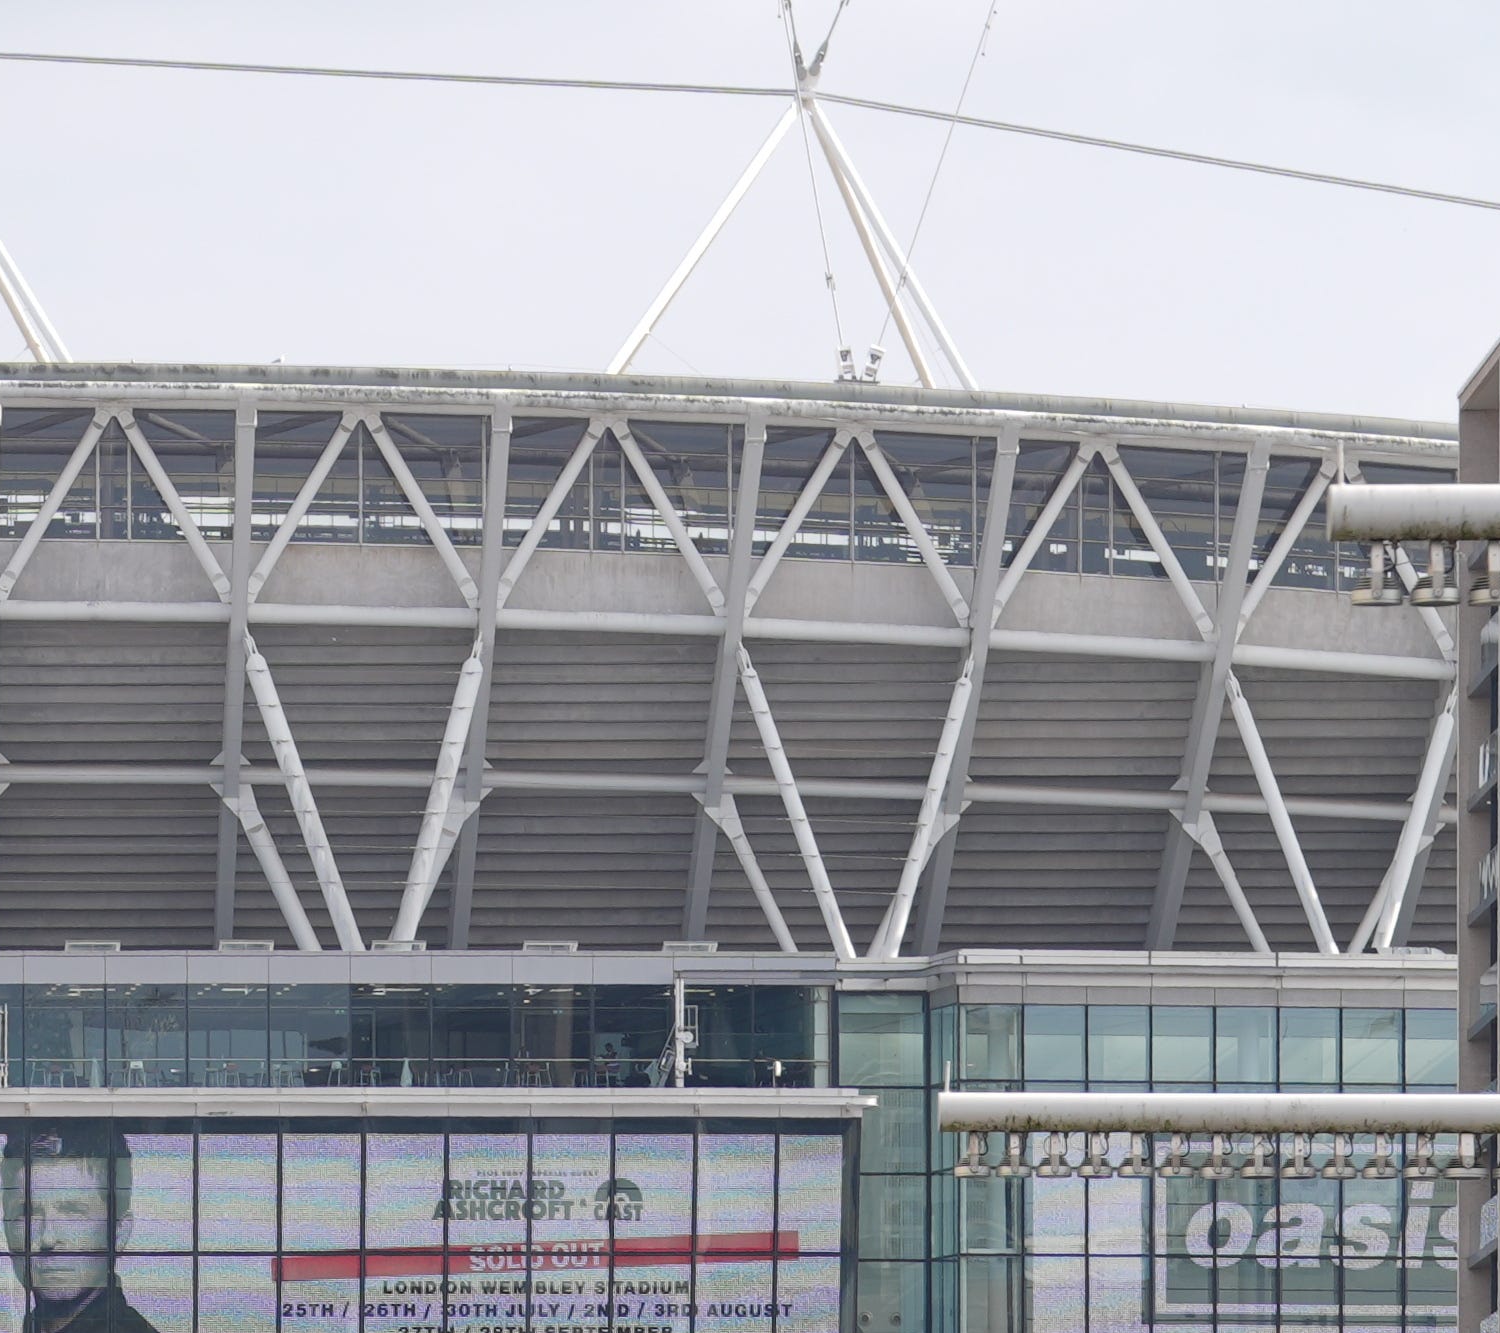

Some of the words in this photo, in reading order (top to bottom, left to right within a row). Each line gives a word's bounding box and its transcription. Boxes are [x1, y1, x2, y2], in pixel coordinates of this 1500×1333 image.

[446, 1180, 565, 1199] RICHARD
[432, 1200, 574, 1220] ASHCROFT
[469, 1245, 545, 1271] SOLD
[551, 1241, 602, 1268] OUT
[383, 1280, 472, 1295] LONDON
[483, 1280, 587, 1295] WEMBLEY
[594, 1280, 690, 1295] STADIUM
[282, 1303, 335, 1318] 25TH
[363, 1303, 416, 1318] 26TH
[506, 1303, 561, 1318] JULY
[706, 1303, 793, 1318] AUGUST
